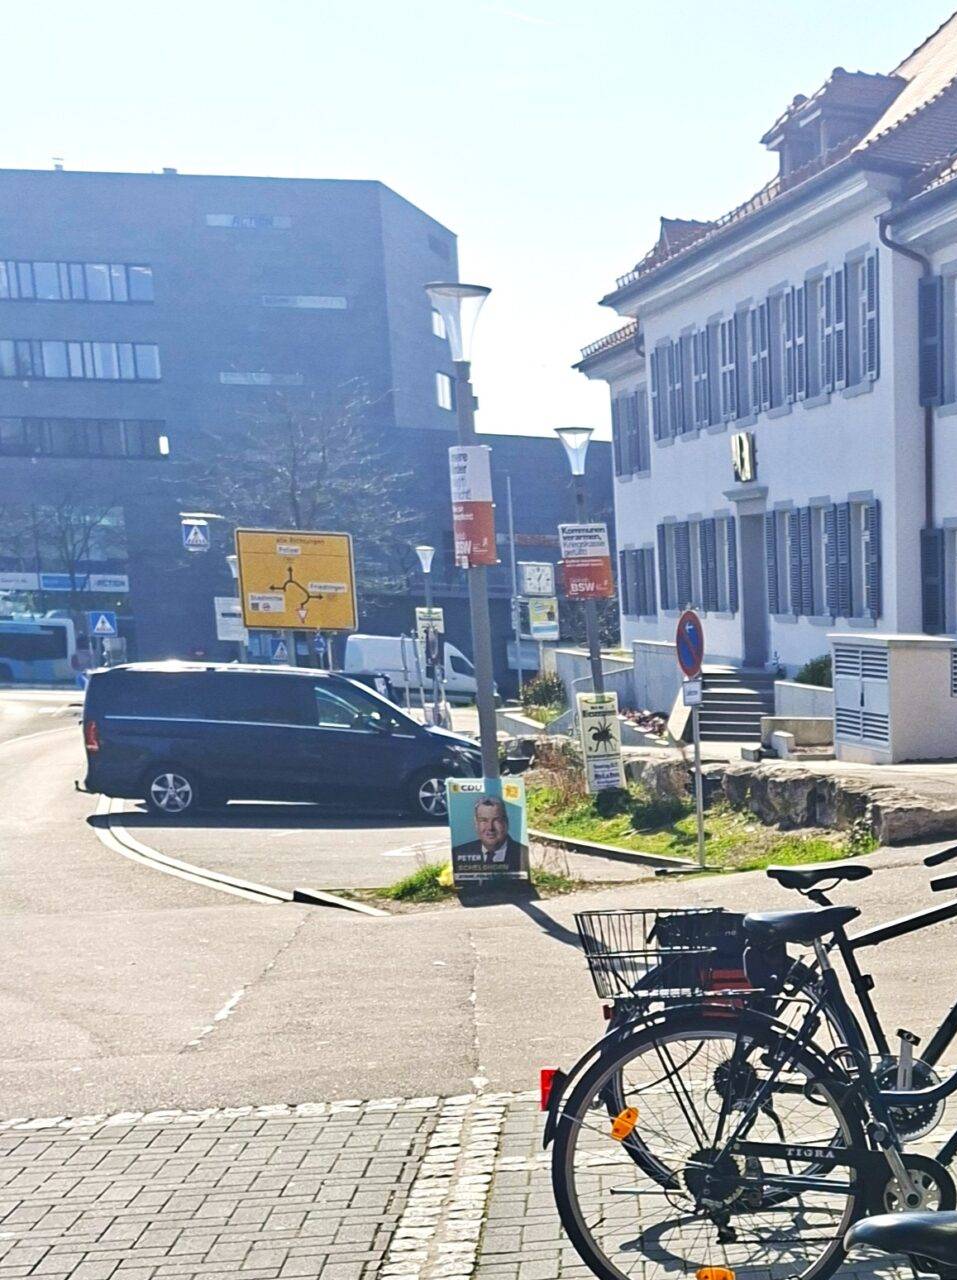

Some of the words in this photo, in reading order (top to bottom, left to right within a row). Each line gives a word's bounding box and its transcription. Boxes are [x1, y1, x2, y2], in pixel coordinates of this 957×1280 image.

[570, 582, 596, 593] BSW
[460, 784, 482, 792] CDU
[457, 854, 482, 862] PETER
[785, 1147, 836, 1159] TIGRA
